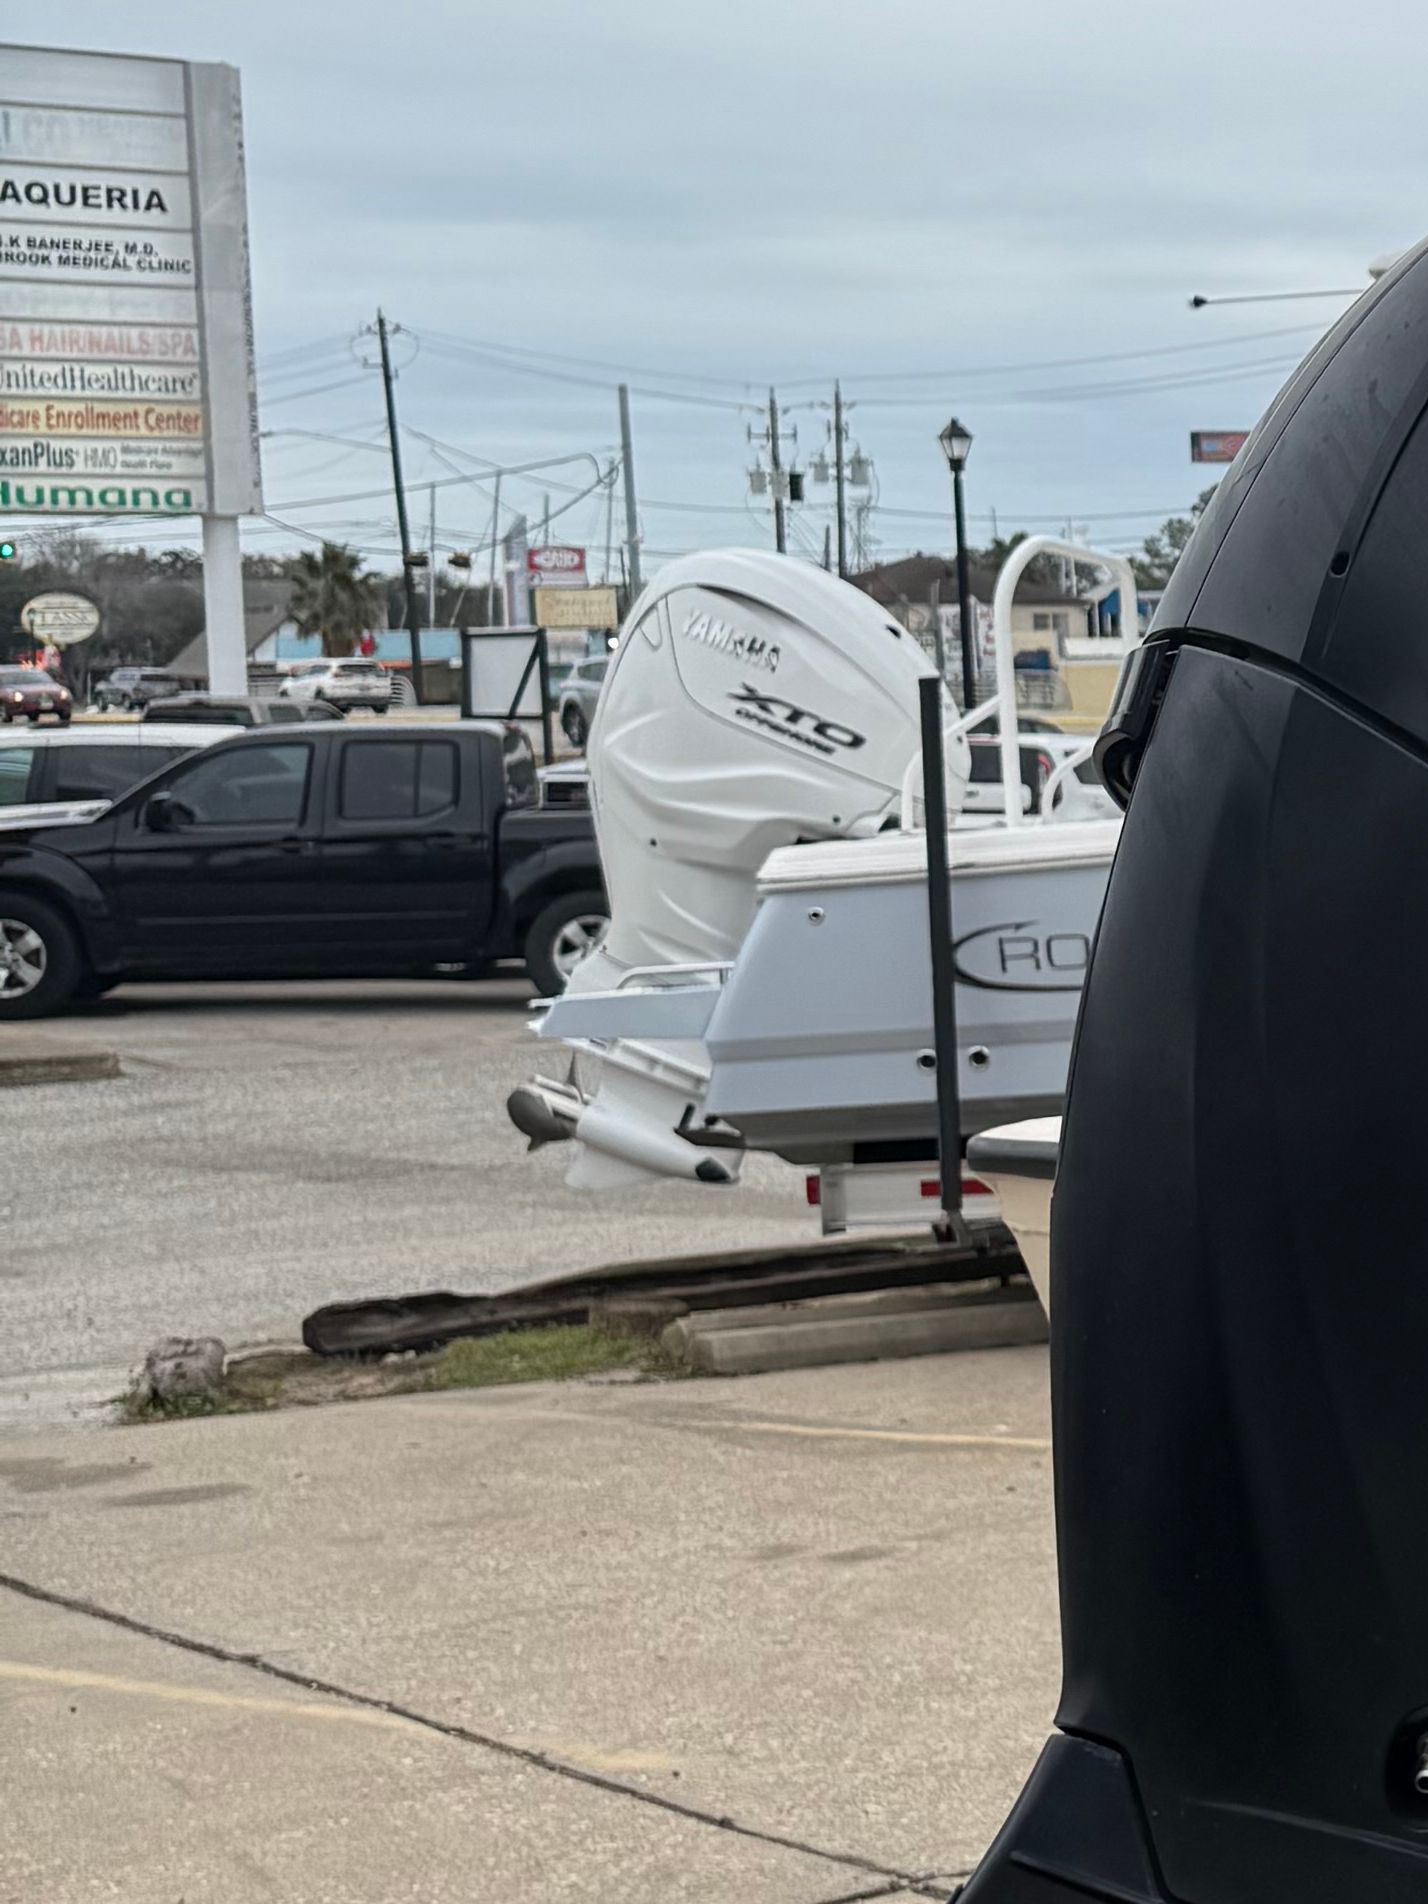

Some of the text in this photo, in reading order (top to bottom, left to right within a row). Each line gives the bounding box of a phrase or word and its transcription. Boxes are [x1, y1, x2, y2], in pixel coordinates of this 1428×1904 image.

[0, 179, 168, 213] AQUERIA
[0, 250, 192, 274] ROOK MEDICAL CLINIC
[45, 404, 140, 431] Enrollment
[143, 407, 201, 433] Center
[683, 608, 780, 674] YAMAHA
